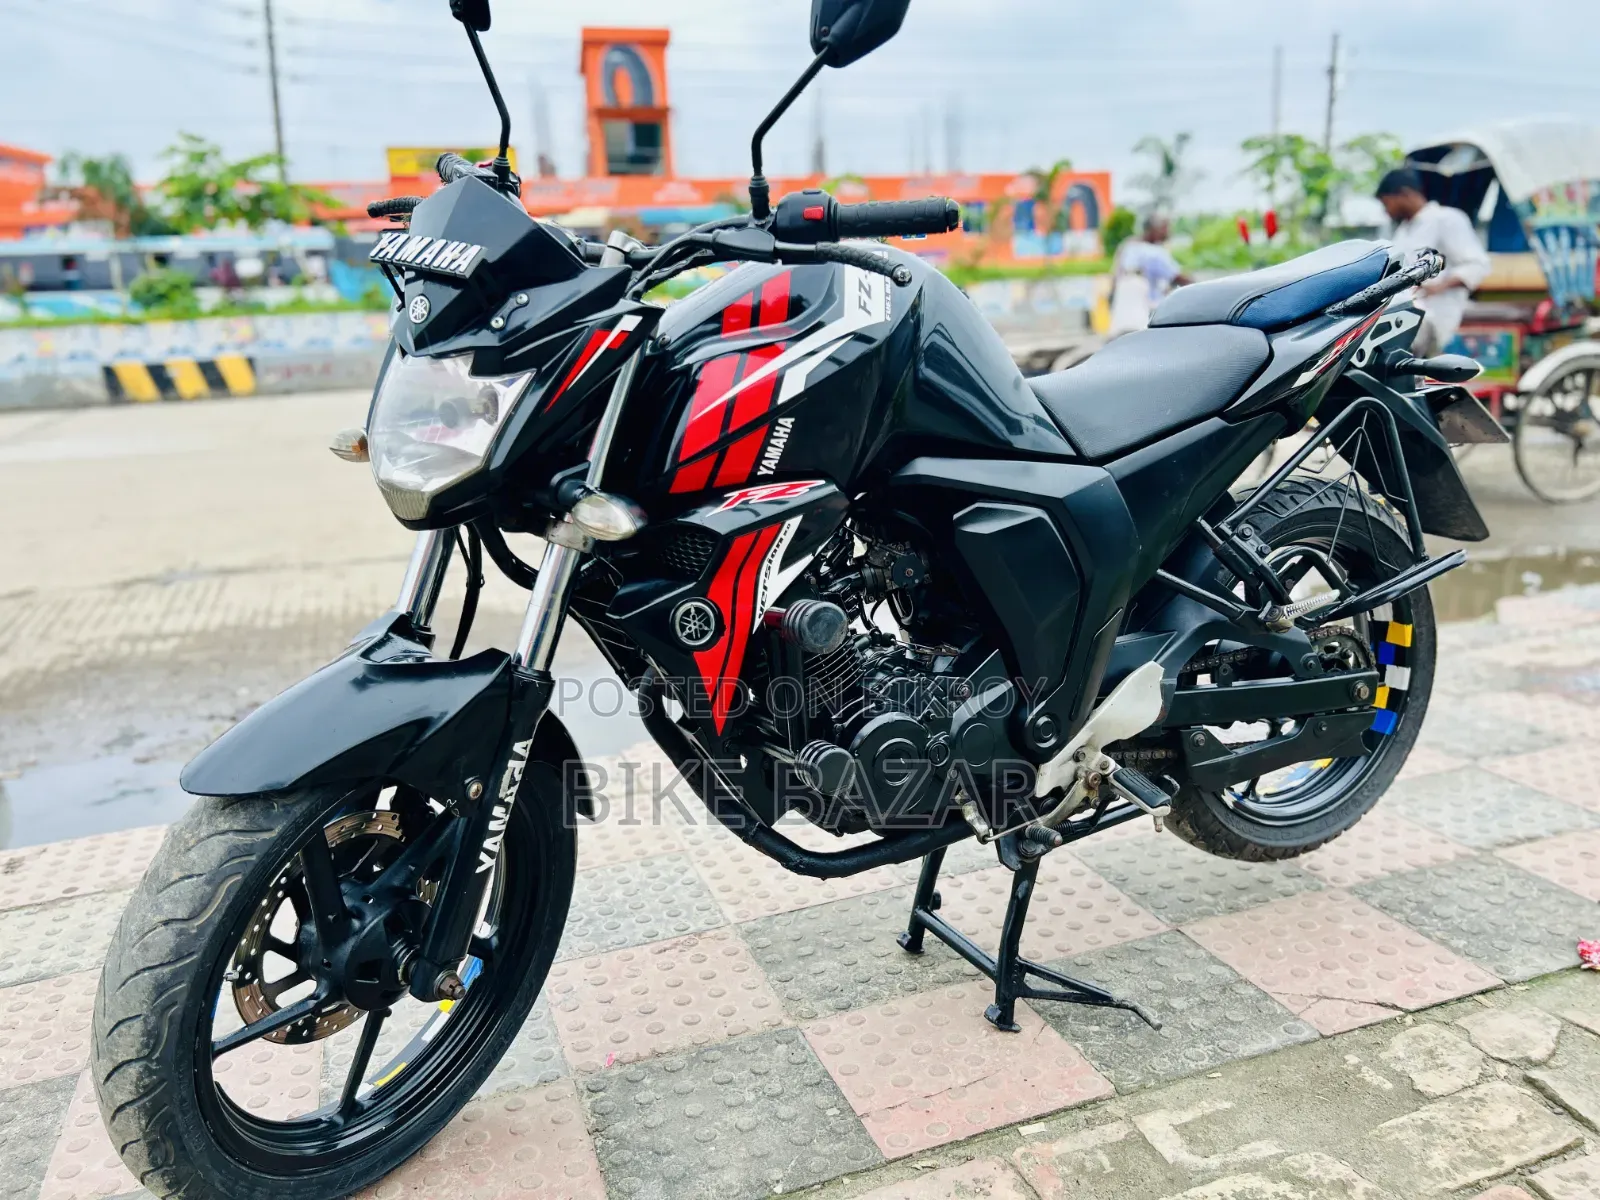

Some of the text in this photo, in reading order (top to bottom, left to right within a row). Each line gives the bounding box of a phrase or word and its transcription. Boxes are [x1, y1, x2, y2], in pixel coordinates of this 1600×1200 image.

[370, 232, 481, 273] YAMAHA
[858, 270, 872, 317] FZ-
[757, 417, 795, 475] YAMAHA
